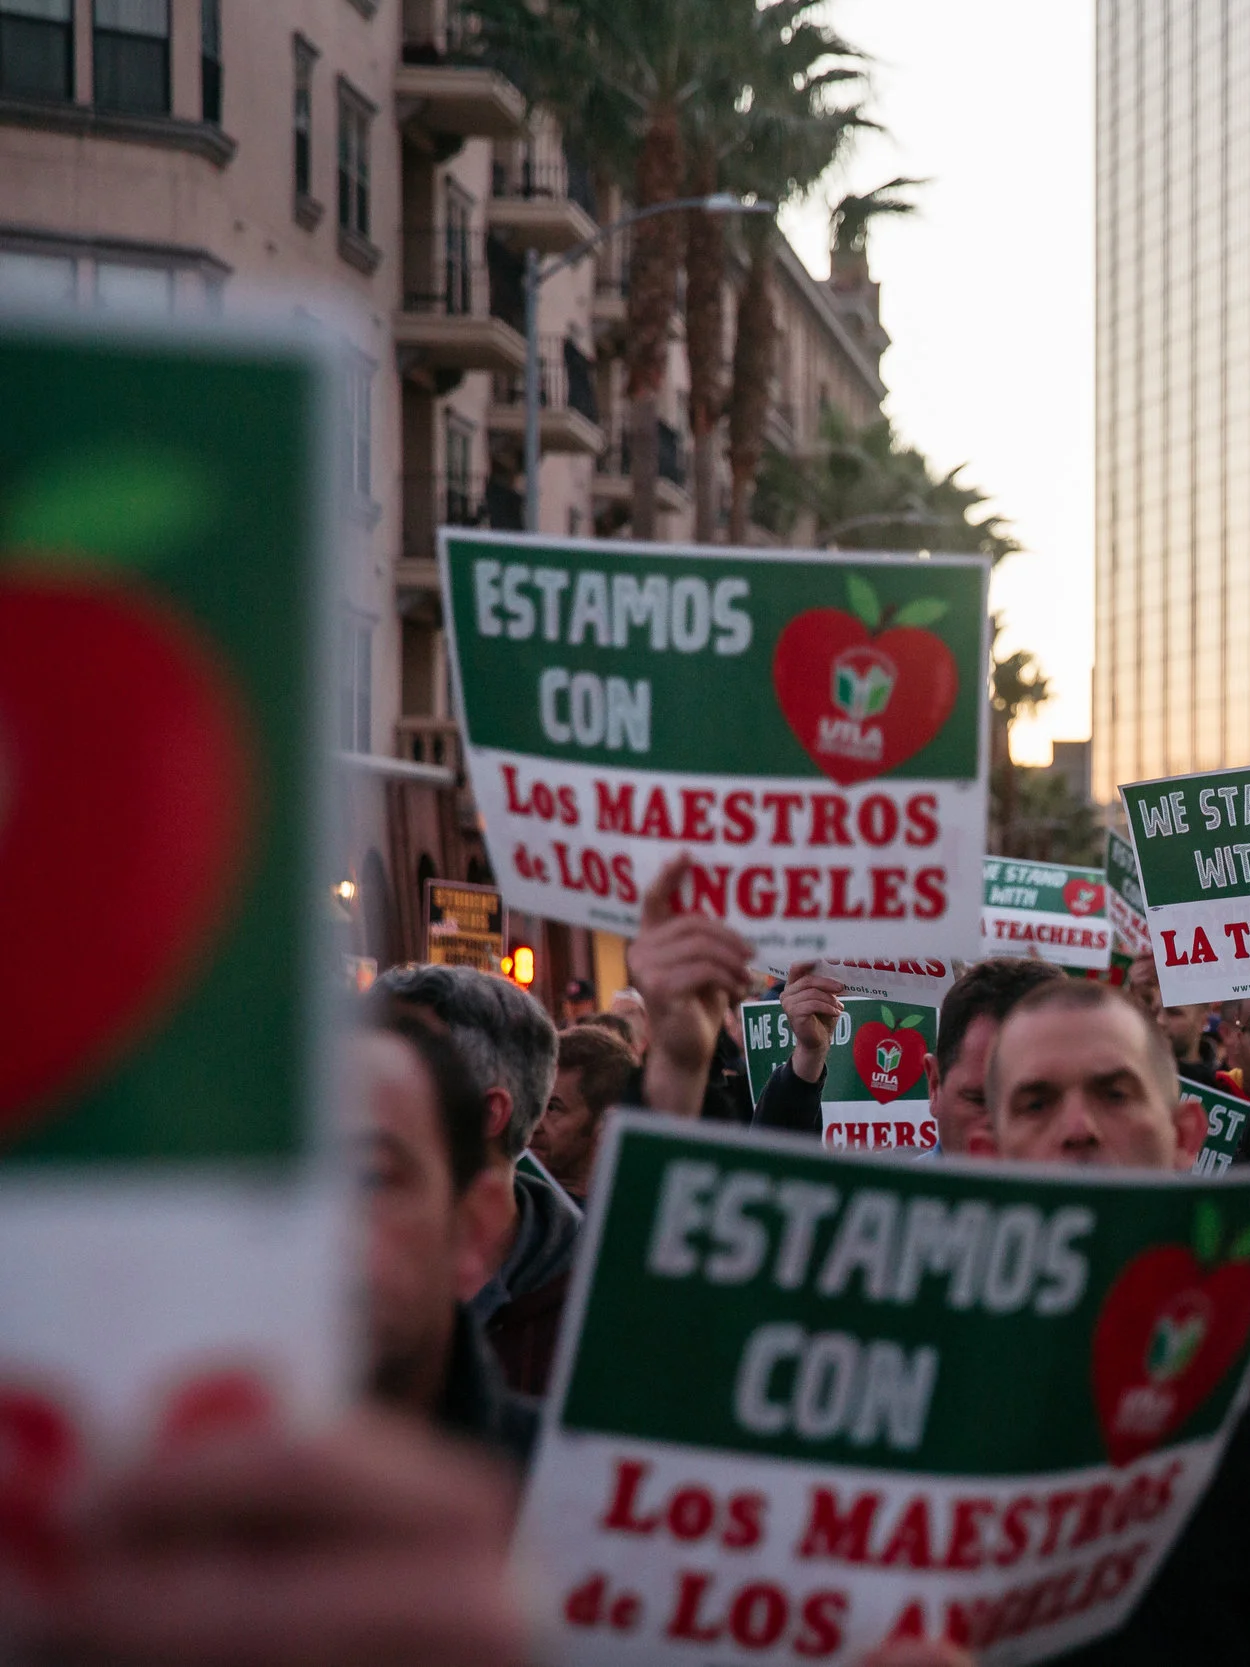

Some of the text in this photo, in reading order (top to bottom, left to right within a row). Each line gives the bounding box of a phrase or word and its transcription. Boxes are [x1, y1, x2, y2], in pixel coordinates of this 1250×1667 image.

[473, 558, 754, 656] ESTAMOS
[538, 667, 653, 754] CON
[594, 778, 939, 848] MAESTROS
[1138, 791, 1190, 839] WE
[553, 840, 639, 905] LOS
[993, 918, 1108, 950] TEACHERS
[1160, 926, 1218, 967] LA
[748, 1013, 772, 1050] WE
[872, 1072, 898, 1086] UTLA
[825, 1120, 938, 1150] CHERS
[647, 1159, 1095, 1318] ESTAMOS
[734, 1322, 939, 1450] CON
[800, 1457, 1184, 1570] MAESTROS
[565, 1574, 643, 1632] de
[666, 1569, 853, 1657] LOS
